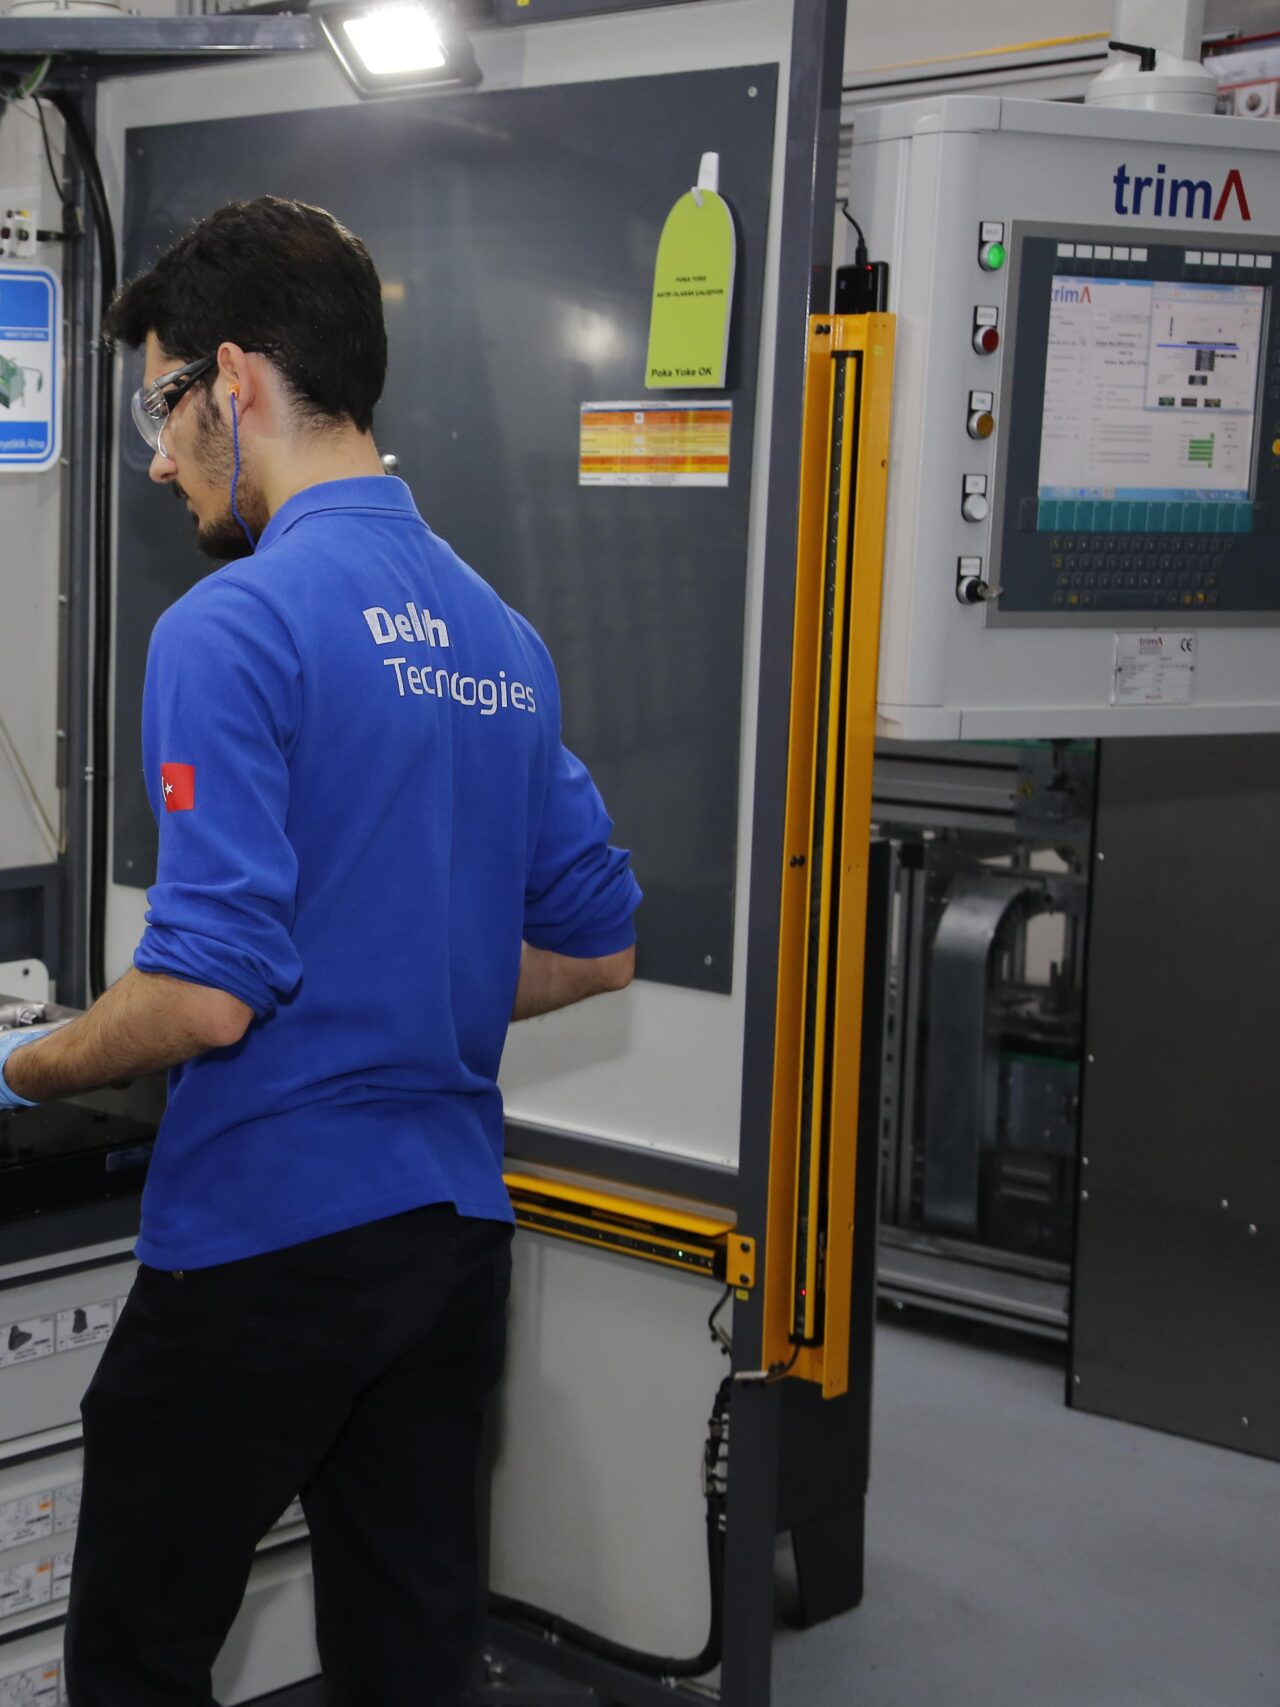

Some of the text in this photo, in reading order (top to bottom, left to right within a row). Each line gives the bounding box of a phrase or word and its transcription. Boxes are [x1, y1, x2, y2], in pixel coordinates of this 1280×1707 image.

[1113, 163, 1251, 220] trimA
[651, 366, 712, 377] Poka Yoke OK
